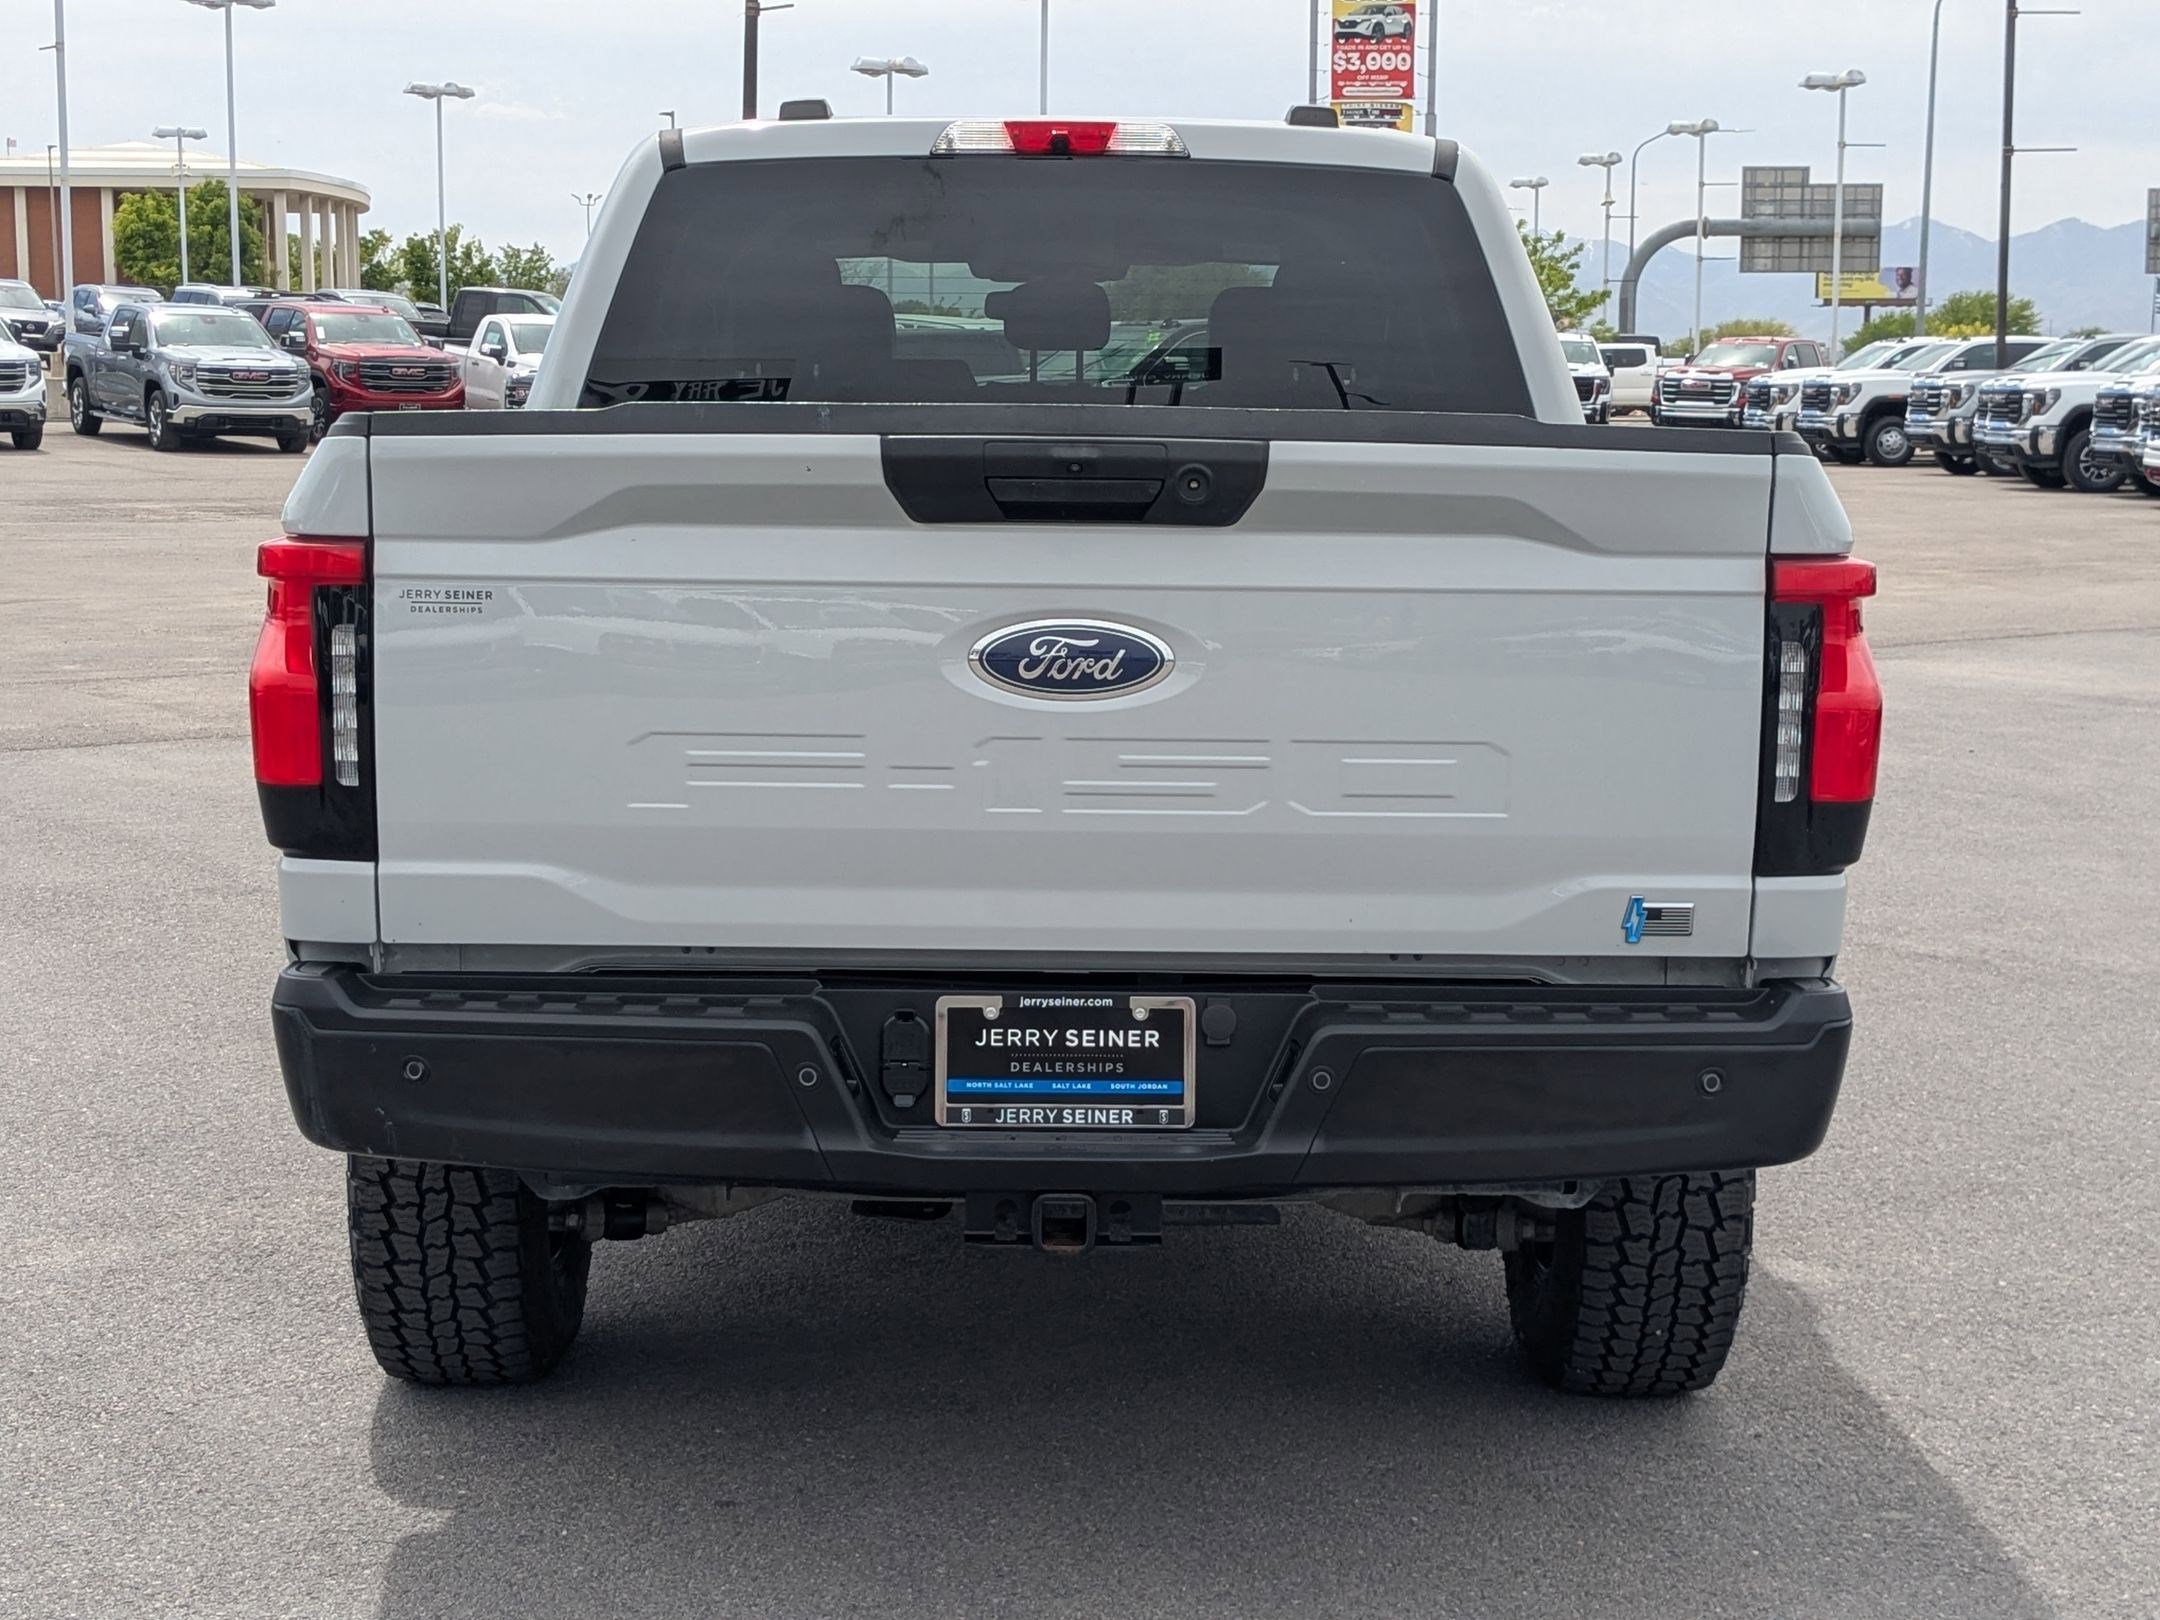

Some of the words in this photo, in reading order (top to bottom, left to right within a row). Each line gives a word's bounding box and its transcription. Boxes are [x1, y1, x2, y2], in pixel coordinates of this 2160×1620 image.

[232, 371, 269, 380] GMC
[391, 367, 426, 376] GMC
[399, 589, 441, 599] JERRY
[445, 590, 493, 600] SEINER
[1018, 636, 1126, 680] Ford
[1019, 996, 1113, 1008] jerryseiner.com
[975, 1028, 1058, 1047] JERRY
[1065, 1030, 1160, 1048] SEINER
[1010, 1062, 1124, 1073] DEALERSHIPS
[995, 1108, 1058, 1123] JERRY
[1062, 1109, 1133, 1124] SEINER
